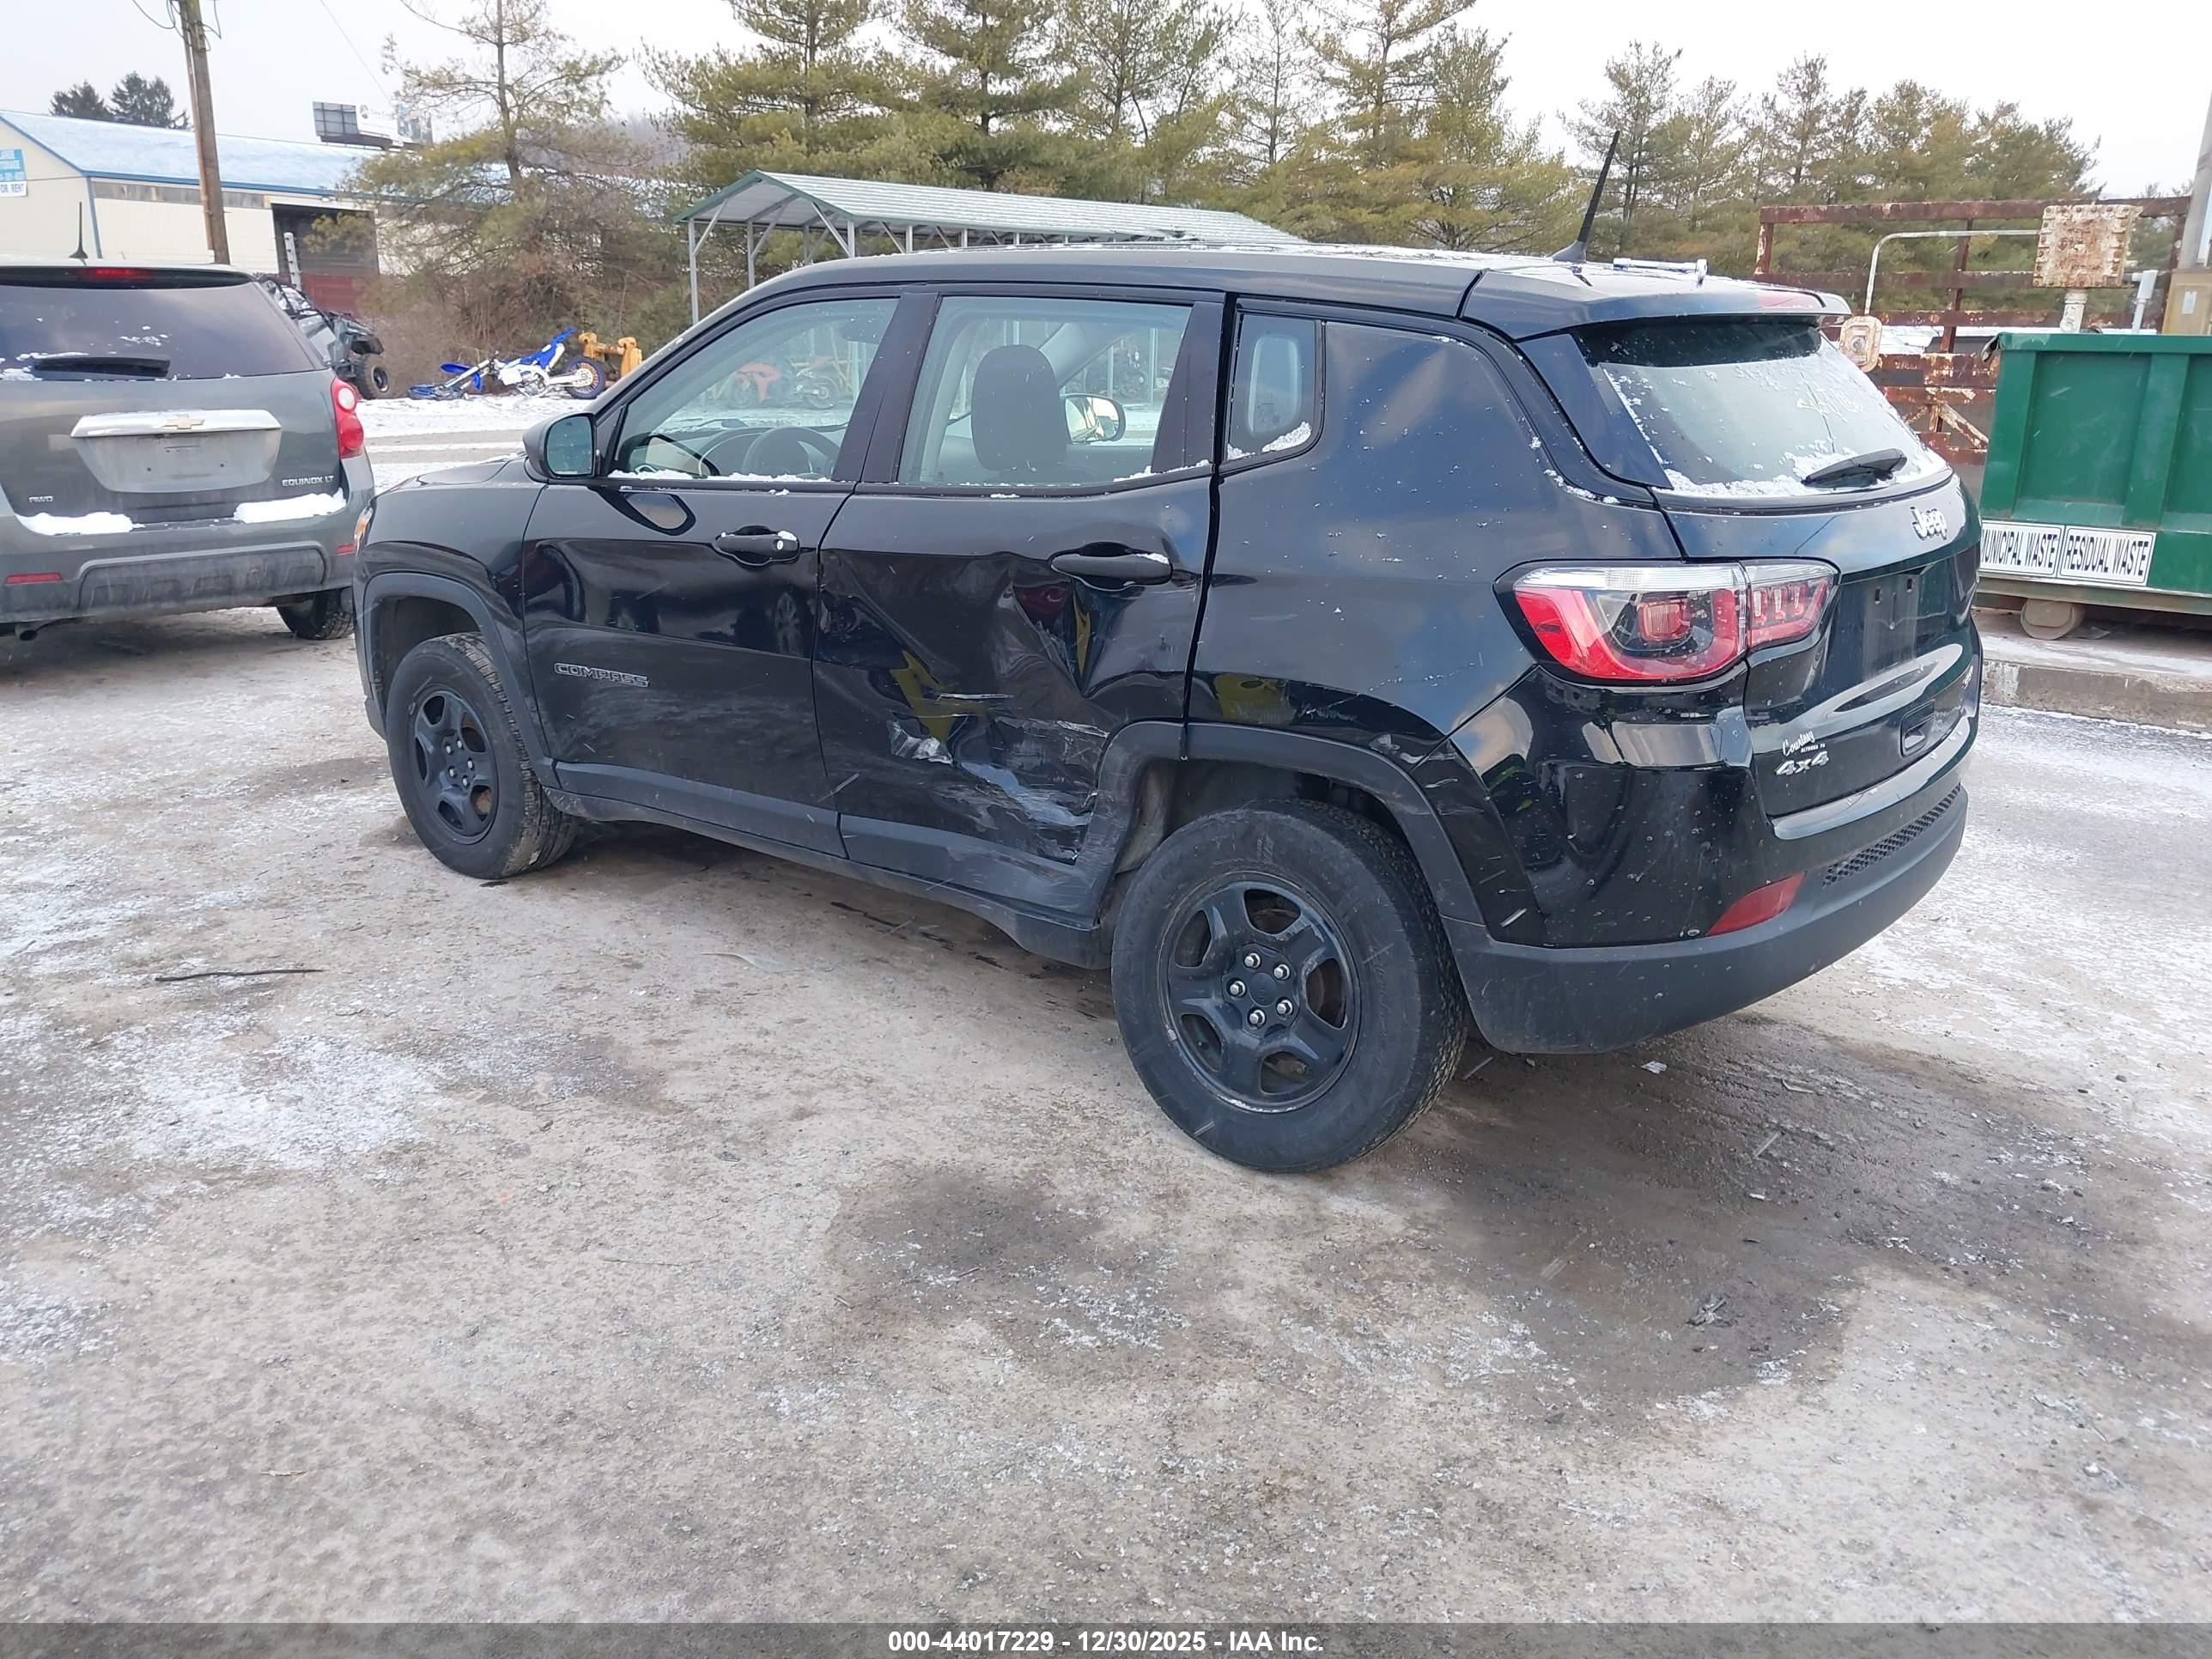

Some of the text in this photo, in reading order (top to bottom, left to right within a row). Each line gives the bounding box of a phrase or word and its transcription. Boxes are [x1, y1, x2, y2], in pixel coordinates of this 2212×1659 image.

[282, 477, 324, 487] EQUINOX
[1910, 506, 1948, 540] Jeep
[2024, 532, 2058, 568] WASTE
[2063, 534, 2150, 576] RESIDUAL WASTE
[554, 662, 650, 688] COMPASS
[1782, 730, 1815, 757] Courtesy
